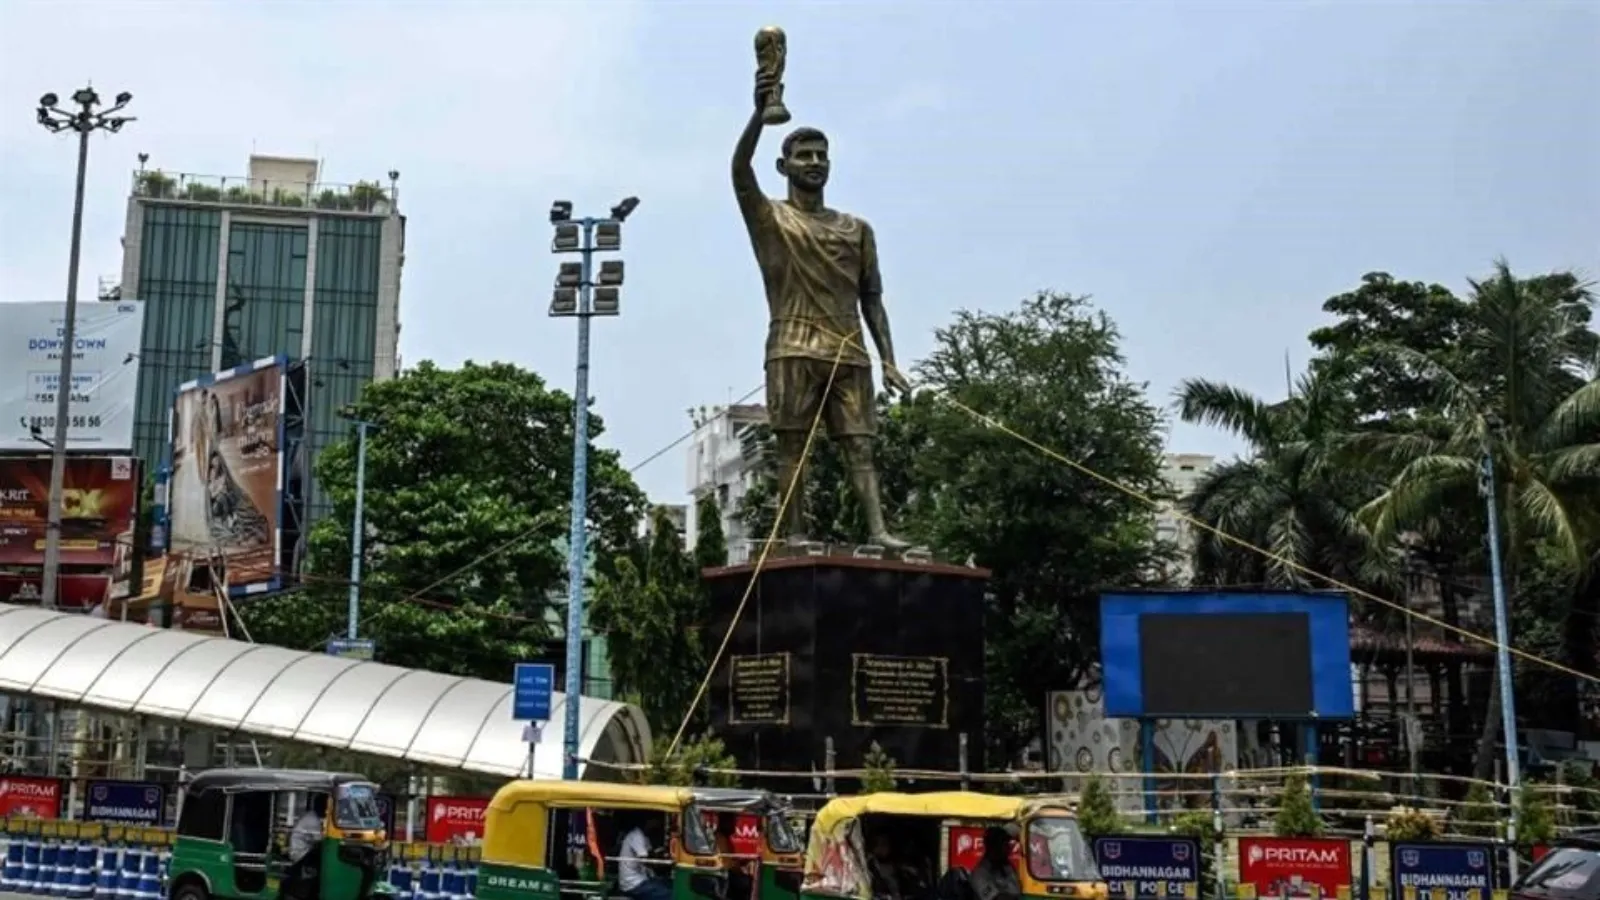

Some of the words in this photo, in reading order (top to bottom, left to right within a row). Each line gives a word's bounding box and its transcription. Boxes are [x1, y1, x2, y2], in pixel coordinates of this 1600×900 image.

[29, 339, 106, 349] DOWOWN
[10, 782, 55, 796] PRITAM
[90, 806, 157, 818] BIDHANNAGAR
[1265, 848, 1338, 862] PRITAM
[1102, 866, 1190, 878] BIDHANNAGAR
[1401, 873, 1486, 887] BIDHANNAGAR
[1141, 881, 1185, 894] POCE
